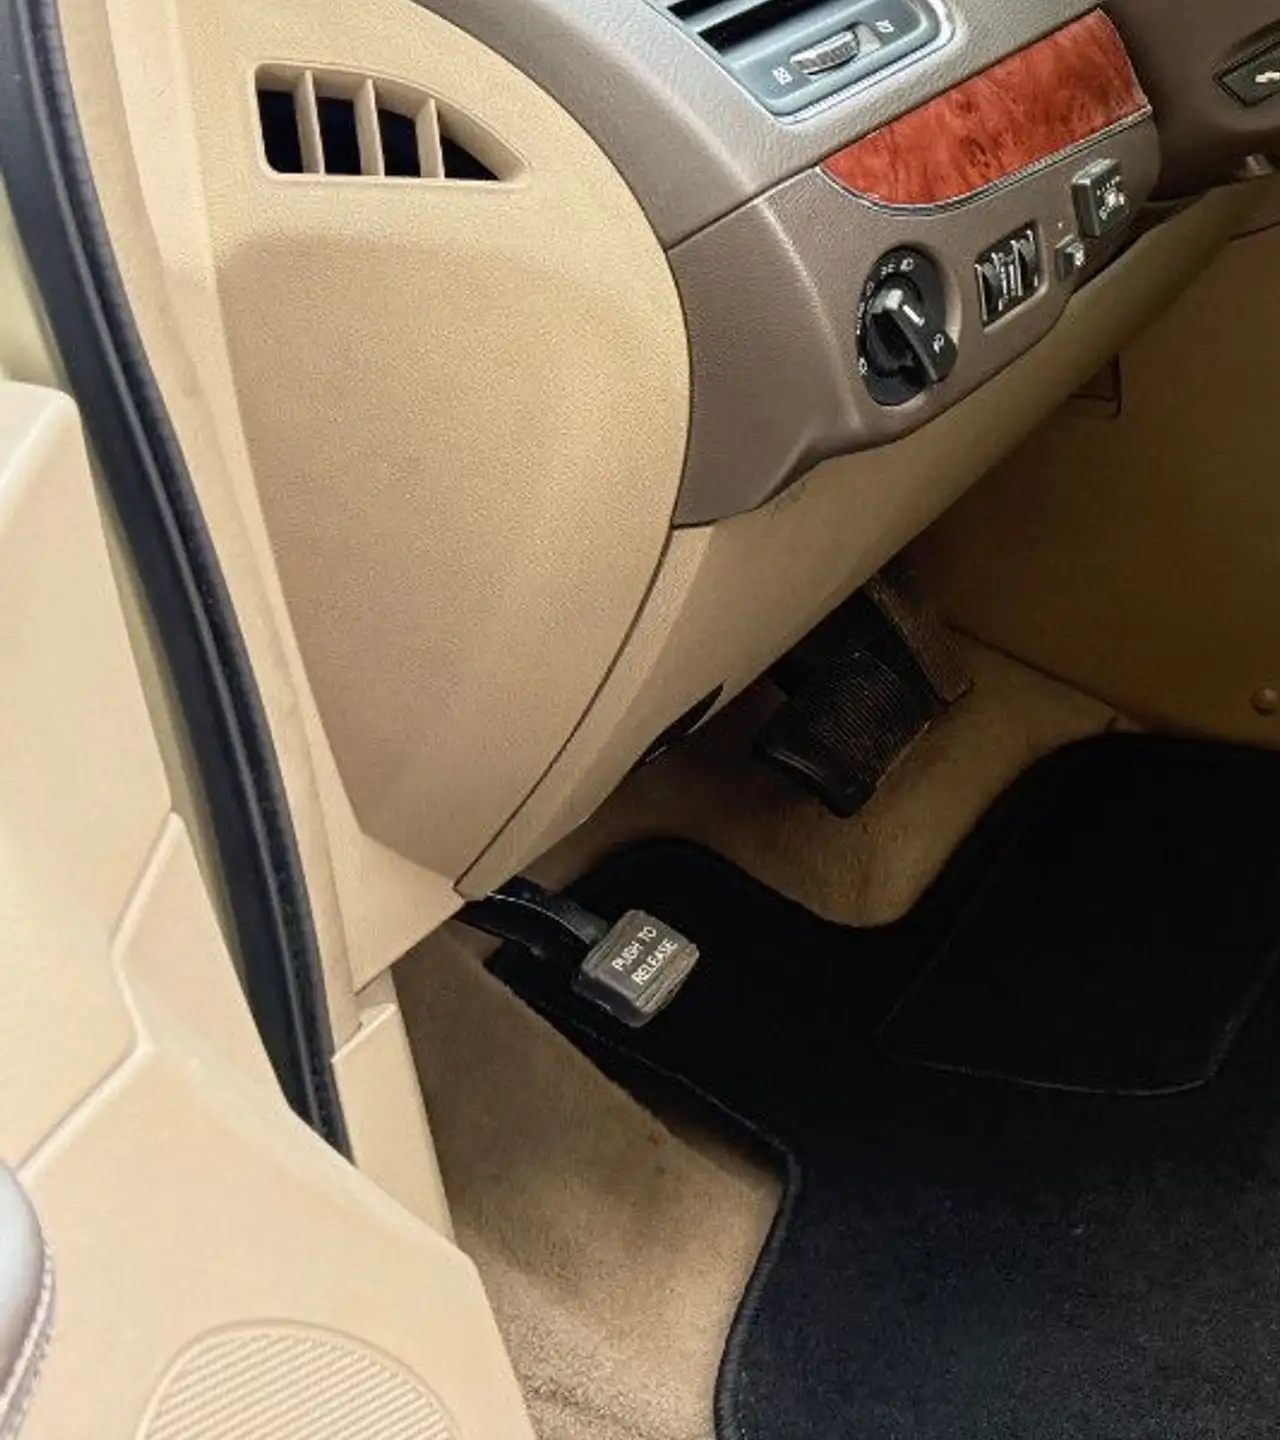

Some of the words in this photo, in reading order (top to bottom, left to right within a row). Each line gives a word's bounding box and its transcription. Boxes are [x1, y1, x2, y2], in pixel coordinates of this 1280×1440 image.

[611, 940, 645, 971] PUSH
[637, 925, 658, 942] TO
[630, 938, 679, 985] RELEASE
